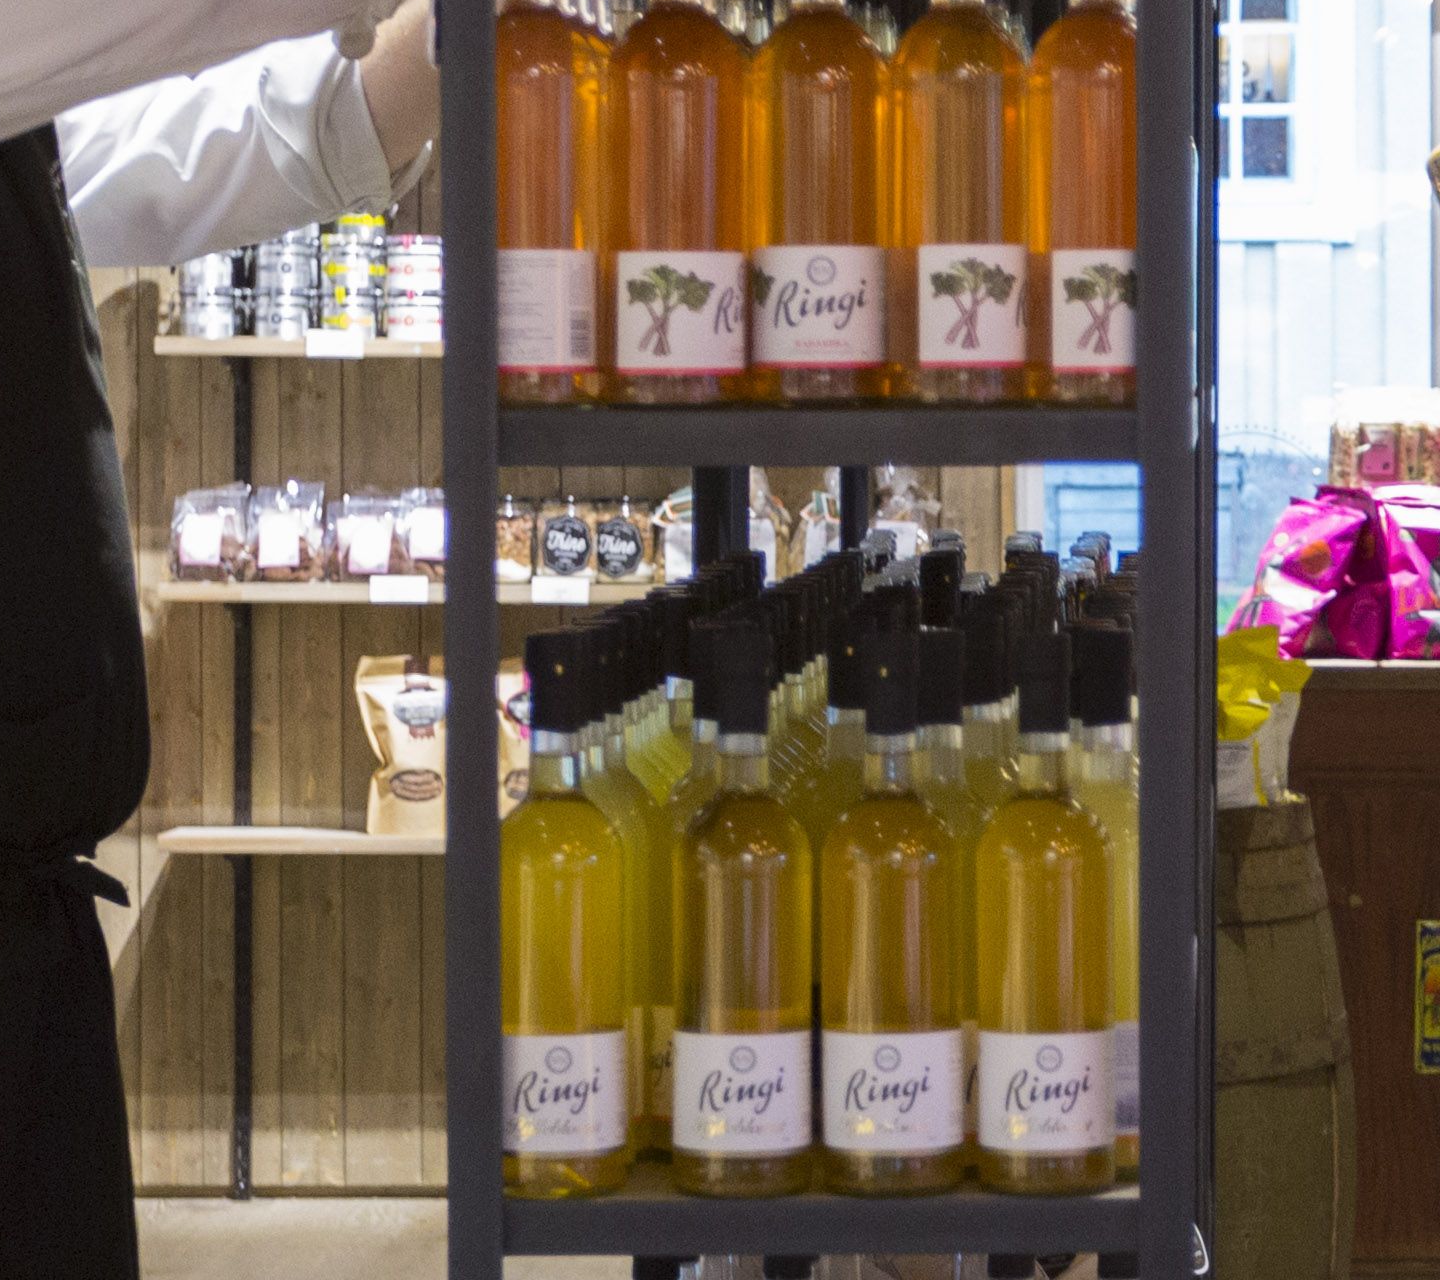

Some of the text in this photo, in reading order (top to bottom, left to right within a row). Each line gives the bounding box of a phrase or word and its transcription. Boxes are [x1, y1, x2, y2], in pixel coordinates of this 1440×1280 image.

[773, 278, 867, 331] Ringi
[513, 1066, 600, 1115] Ringi
[699, 1066, 784, 1115] Ringi
[845, 1066, 931, 1114] Ringi
[1005, 1066, 1091, 1114] Ringi
